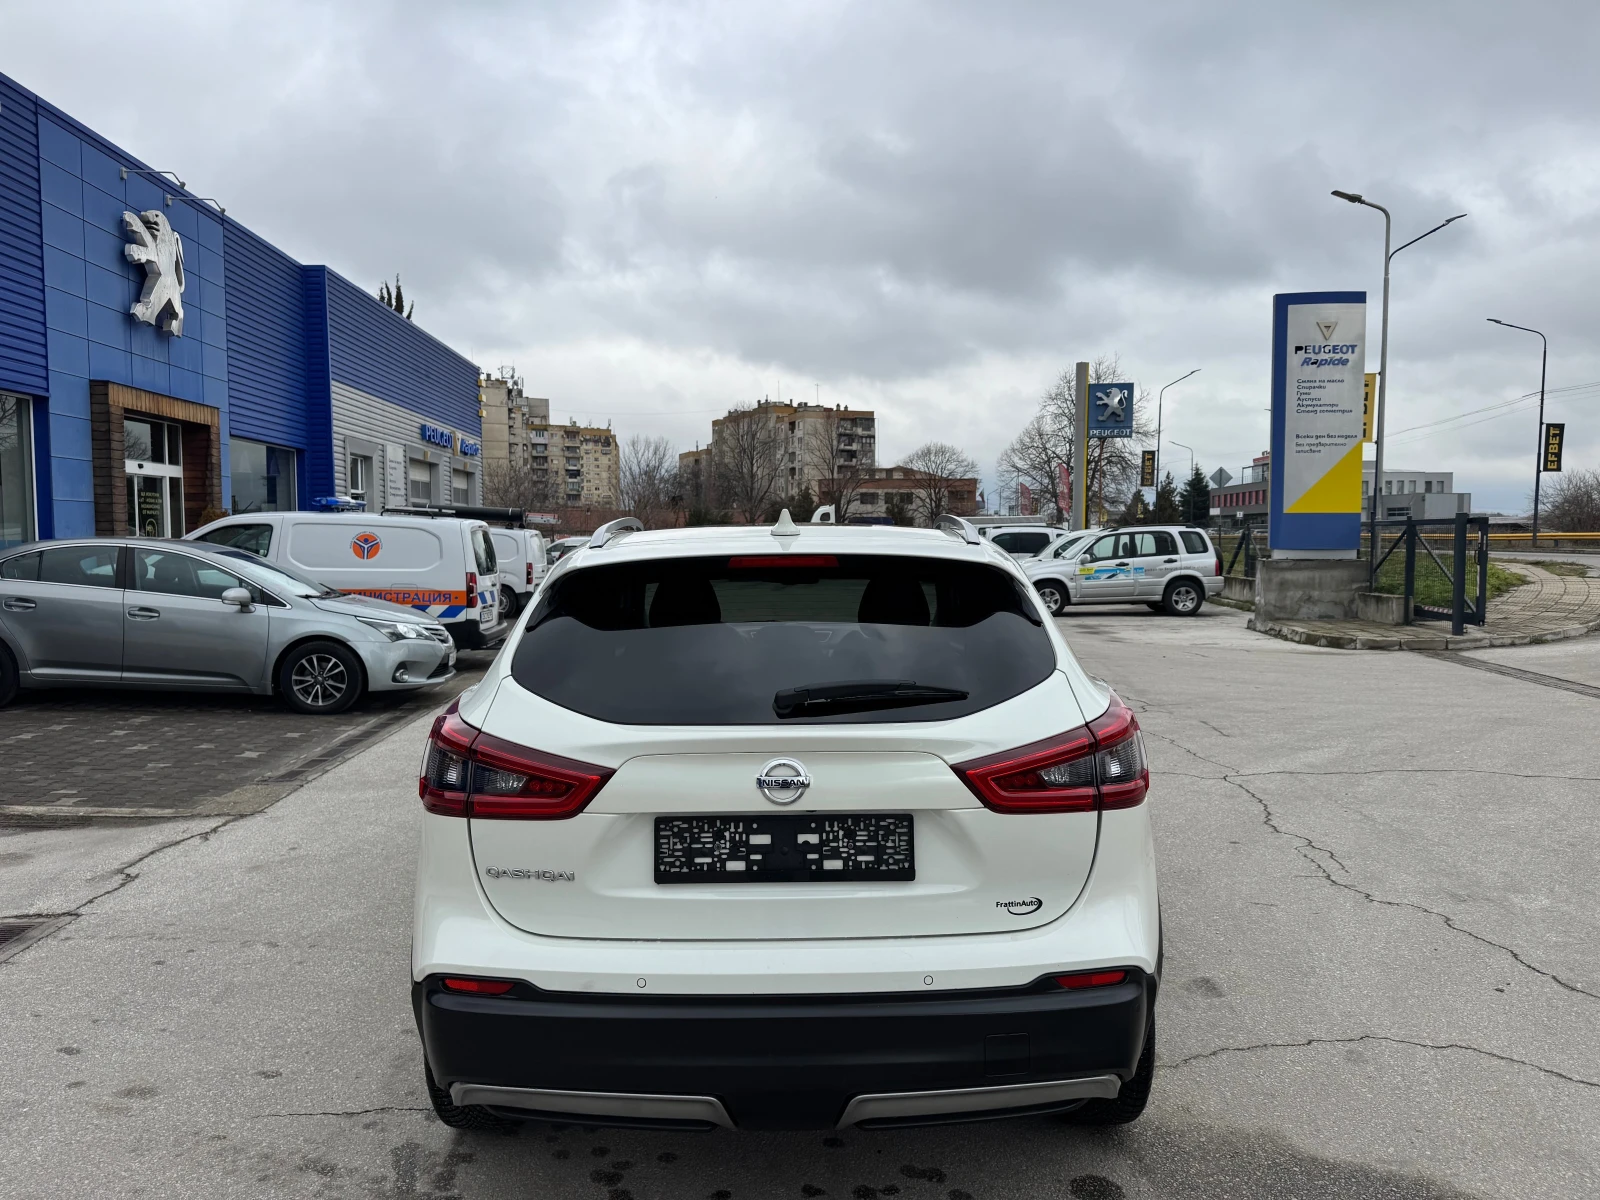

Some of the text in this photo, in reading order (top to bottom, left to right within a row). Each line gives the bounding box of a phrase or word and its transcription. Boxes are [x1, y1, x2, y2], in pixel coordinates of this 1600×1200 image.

[1294, 344, 1358, 355] PEUGEOT
[1300, 355, 1350, 368] Rapide
[425, 424, 454, 449] PEUGEOT
[1089, 428, 1132, 437] PEUGEOT
[1547, 426, 1560, 469] EFBET
[762, 779, 804, 787] NISSAN
[485, 865, 575, 882] QASHQAI
[995, 899, 1039, 908] FrattinAuto
